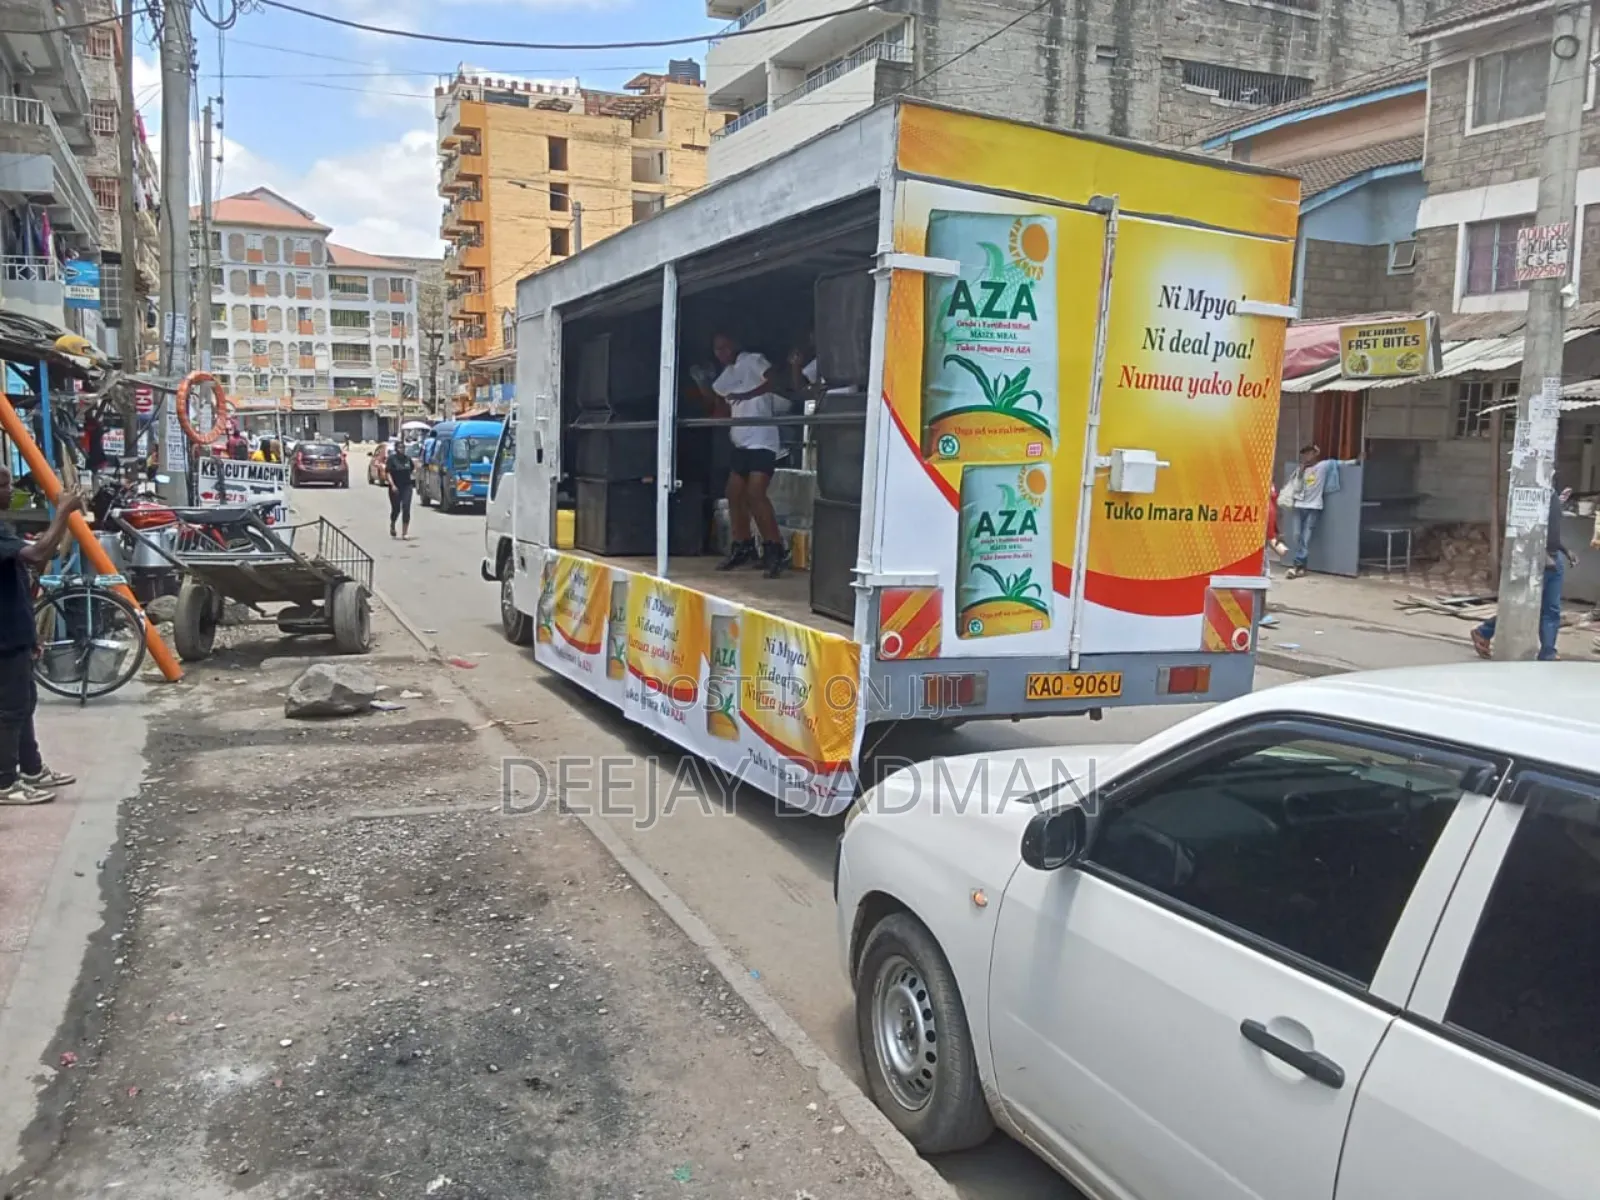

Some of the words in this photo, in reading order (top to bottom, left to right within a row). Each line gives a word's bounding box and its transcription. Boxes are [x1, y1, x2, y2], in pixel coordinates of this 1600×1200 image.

[947, 279, 1038, 321] AZA
[1157, 285, 1181, 309] Ni
[1183, 288, 1247, 320] Mpya
[1142, 327, 1165, 353] Ni
[1169, 329, 1211, 356] deal
[1211, 338, 1255, 363] poa!
[1348, 338, 1379, 350] FAST
[1383, 335, 1421, 348] BITES
[1117, 365, 1184, 392] Nunua
[1187, 371, 1232, 399] yako
[1236, 374, 1272, 399] leo!
[225, 463, 247, 478] CUT
[974, 509, 1038, 538] AZA
[1104, 501, 1144, 521] Tuko
[1148, 502, 1193, 521] Imara
[1198, 504, 1218, 521] Na
[1221, 505, 1259, 522] AZA!
[764, 636, 775, 653] Ni
[1028, 674, 1064, 696] KAQ
[1074, 673, 1122, 695] 906U
